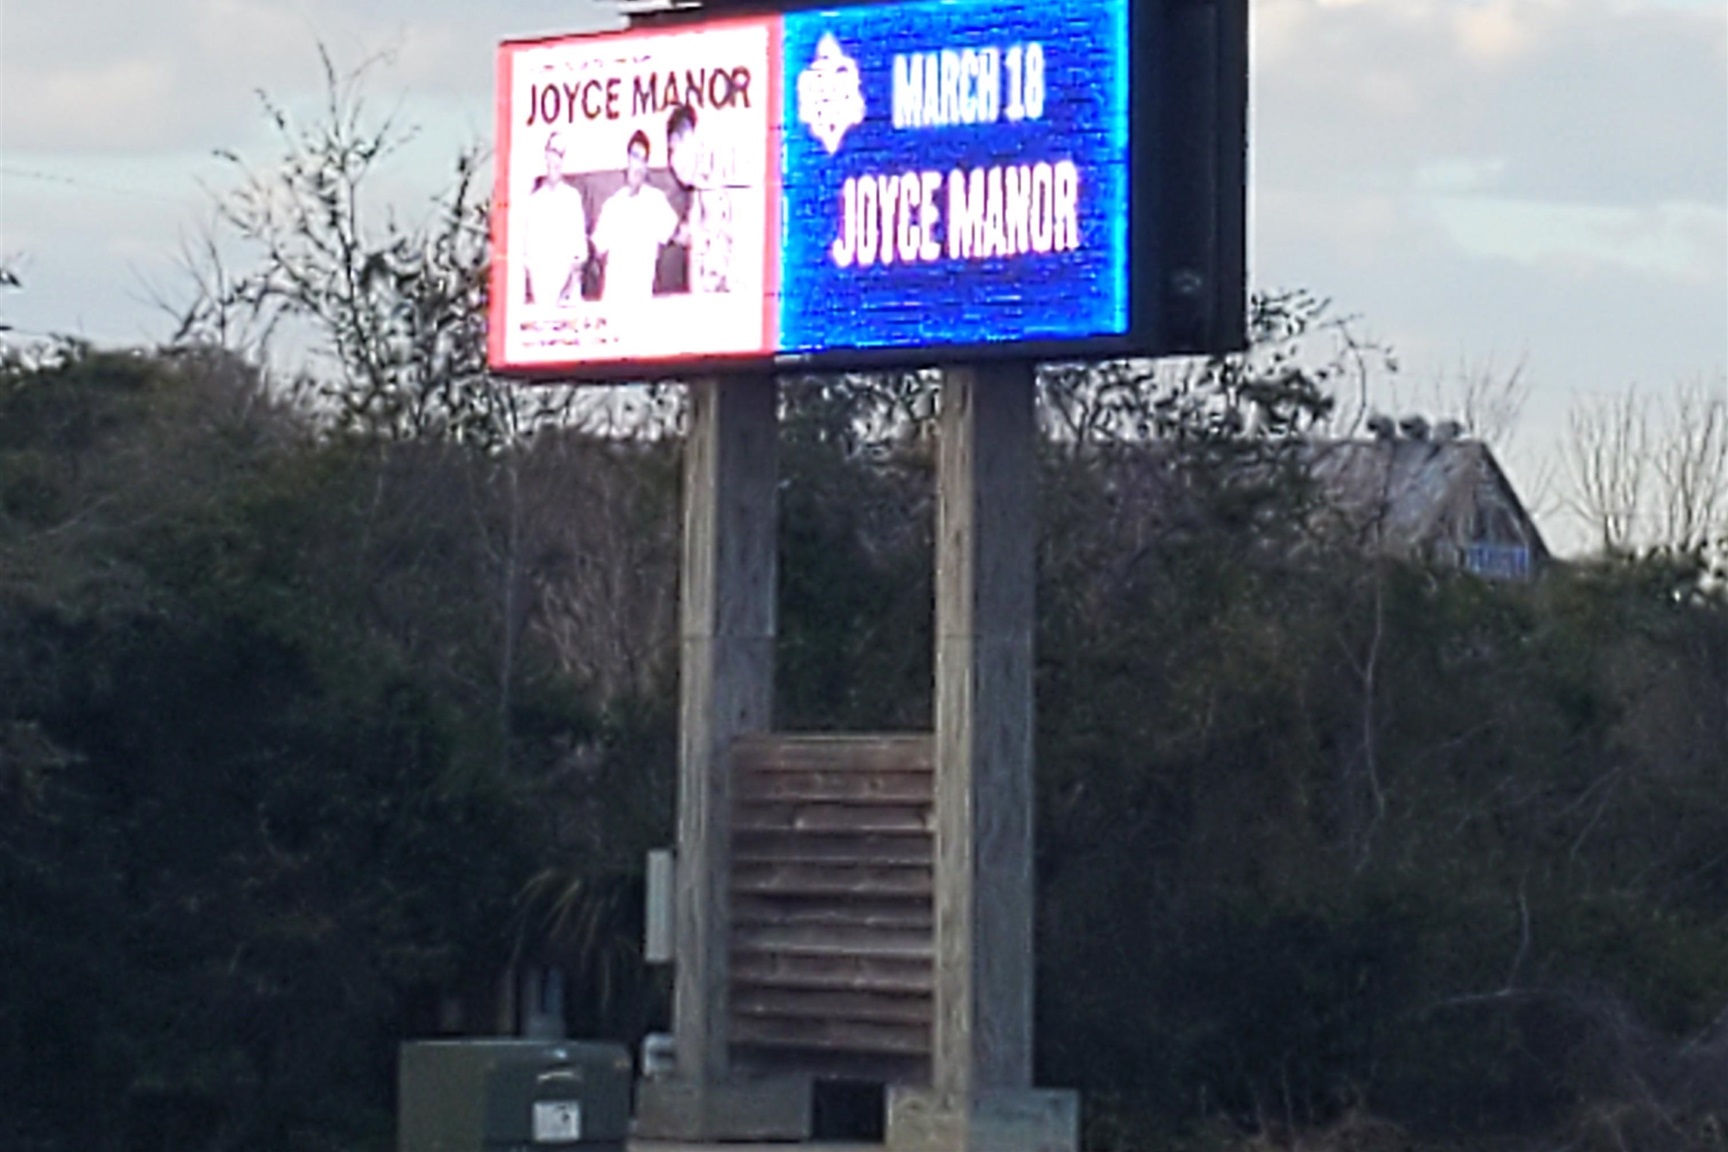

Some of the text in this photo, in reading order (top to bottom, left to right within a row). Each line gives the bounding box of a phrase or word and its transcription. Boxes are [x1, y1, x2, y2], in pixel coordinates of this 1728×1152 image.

[526, 65, 751, 126] JOYCE MANOR
[892, 41, 1045, 129] MARCH 18
[832, 159, 1080, 268] JOYCE MANOR
